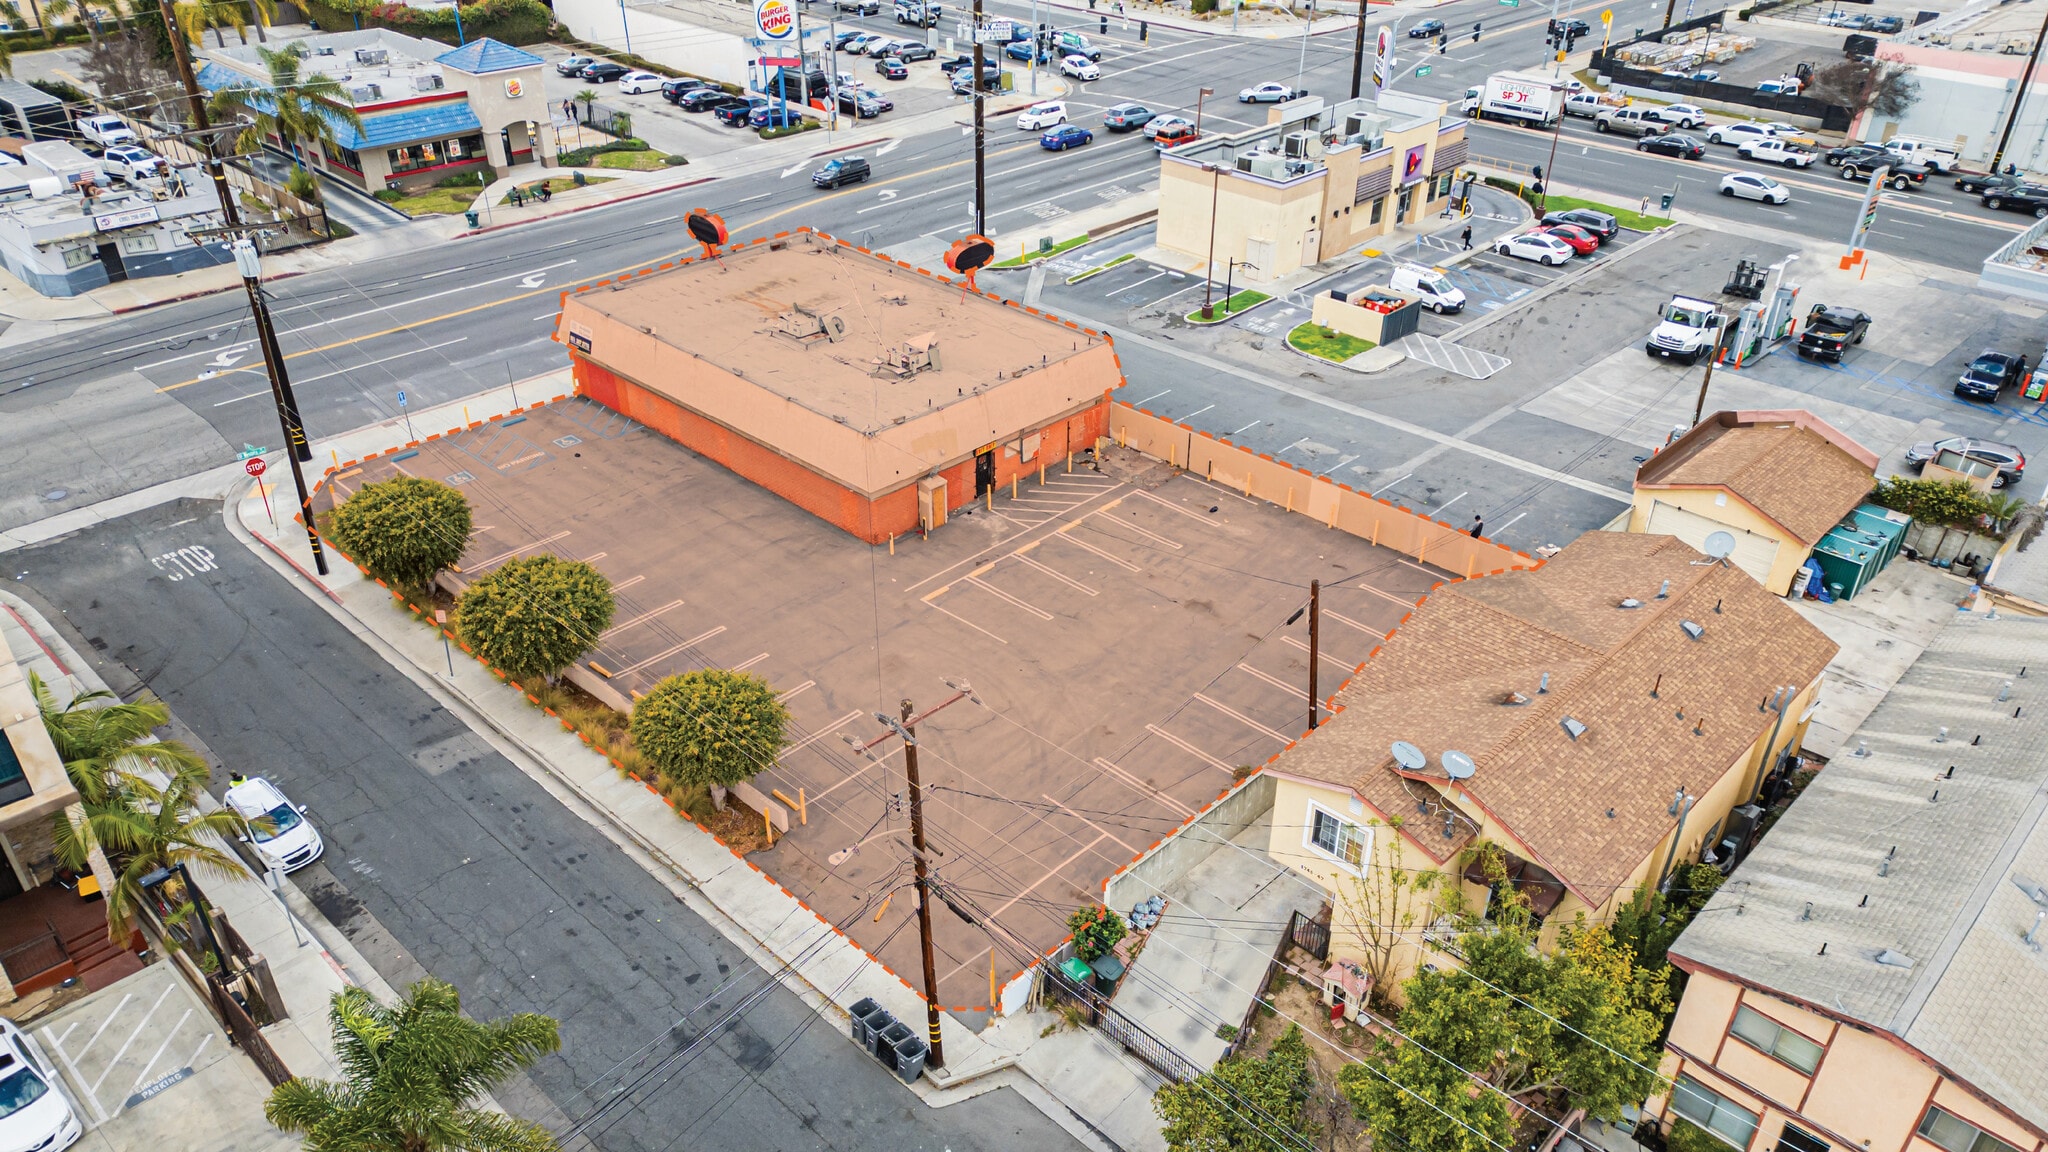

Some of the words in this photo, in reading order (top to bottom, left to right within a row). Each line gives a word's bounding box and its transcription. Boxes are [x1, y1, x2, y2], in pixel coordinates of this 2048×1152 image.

[760, 5, 789, 20] BURGER
[762, 13, 791, 32] KING
[1500, 82, 1536, 96] LIGHTING
[1487, 212, 1519, 221] STOP
[510, 451, 545, 465] PARKING
[246, 461, 265, 473] STOP
[151, 545, 219, 581] STOP
[141, 1073, 182, 1099] PARKING
